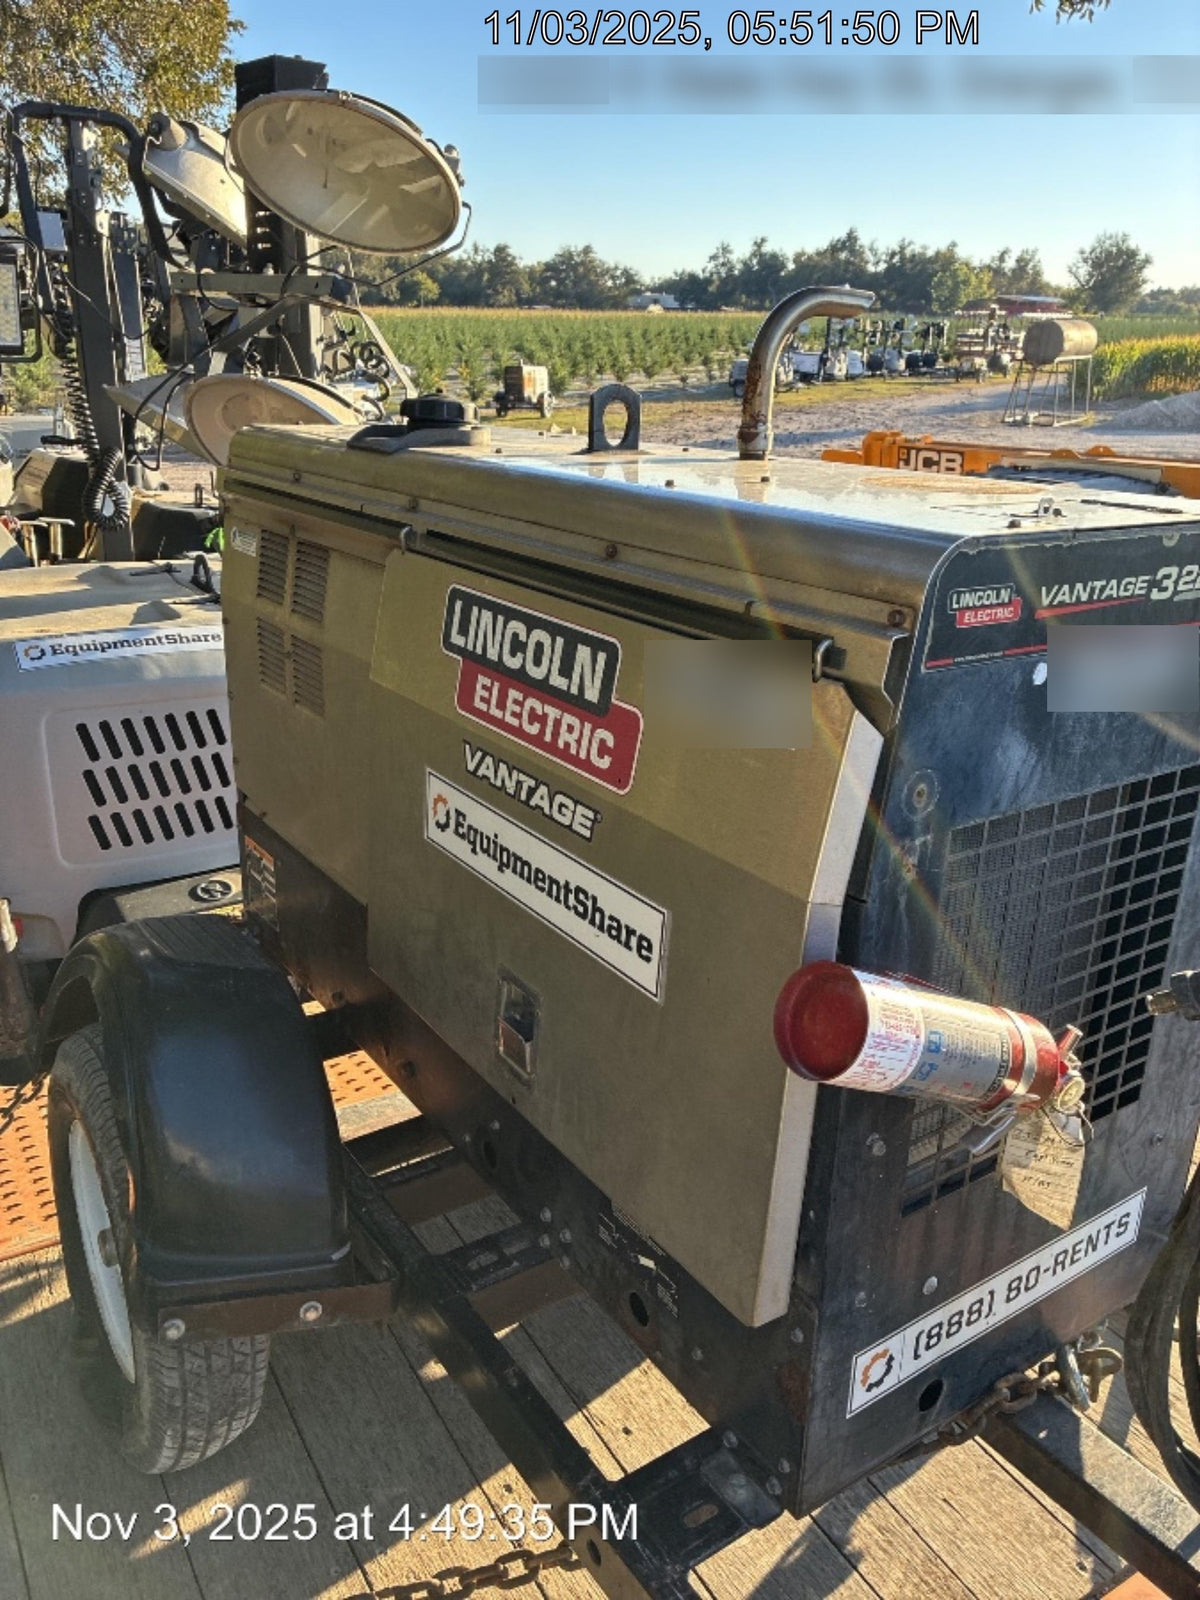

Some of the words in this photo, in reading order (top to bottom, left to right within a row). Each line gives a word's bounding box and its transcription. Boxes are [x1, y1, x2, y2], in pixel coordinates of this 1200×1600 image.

[899, 449, 963, 474] JCB
[952, 587, 1011, 609] LINCOLN
[1040, 575, 1152, 607] VANTAGE
[1150, 565, 1200, 601] 32
[963, 607, 1015, 624] ELECTRIC
[48, 632, 222, 657] EquipmentShare
[450, 599, 607, 704] LINCOLN
[473, 673, 614, 769] ELECTRIC
[453, 807, 654, 964] EquipmentShare
[913, 1291, 995, 1360] (888)
[1005, 1212, 1131, 1304] 80-RENTS
